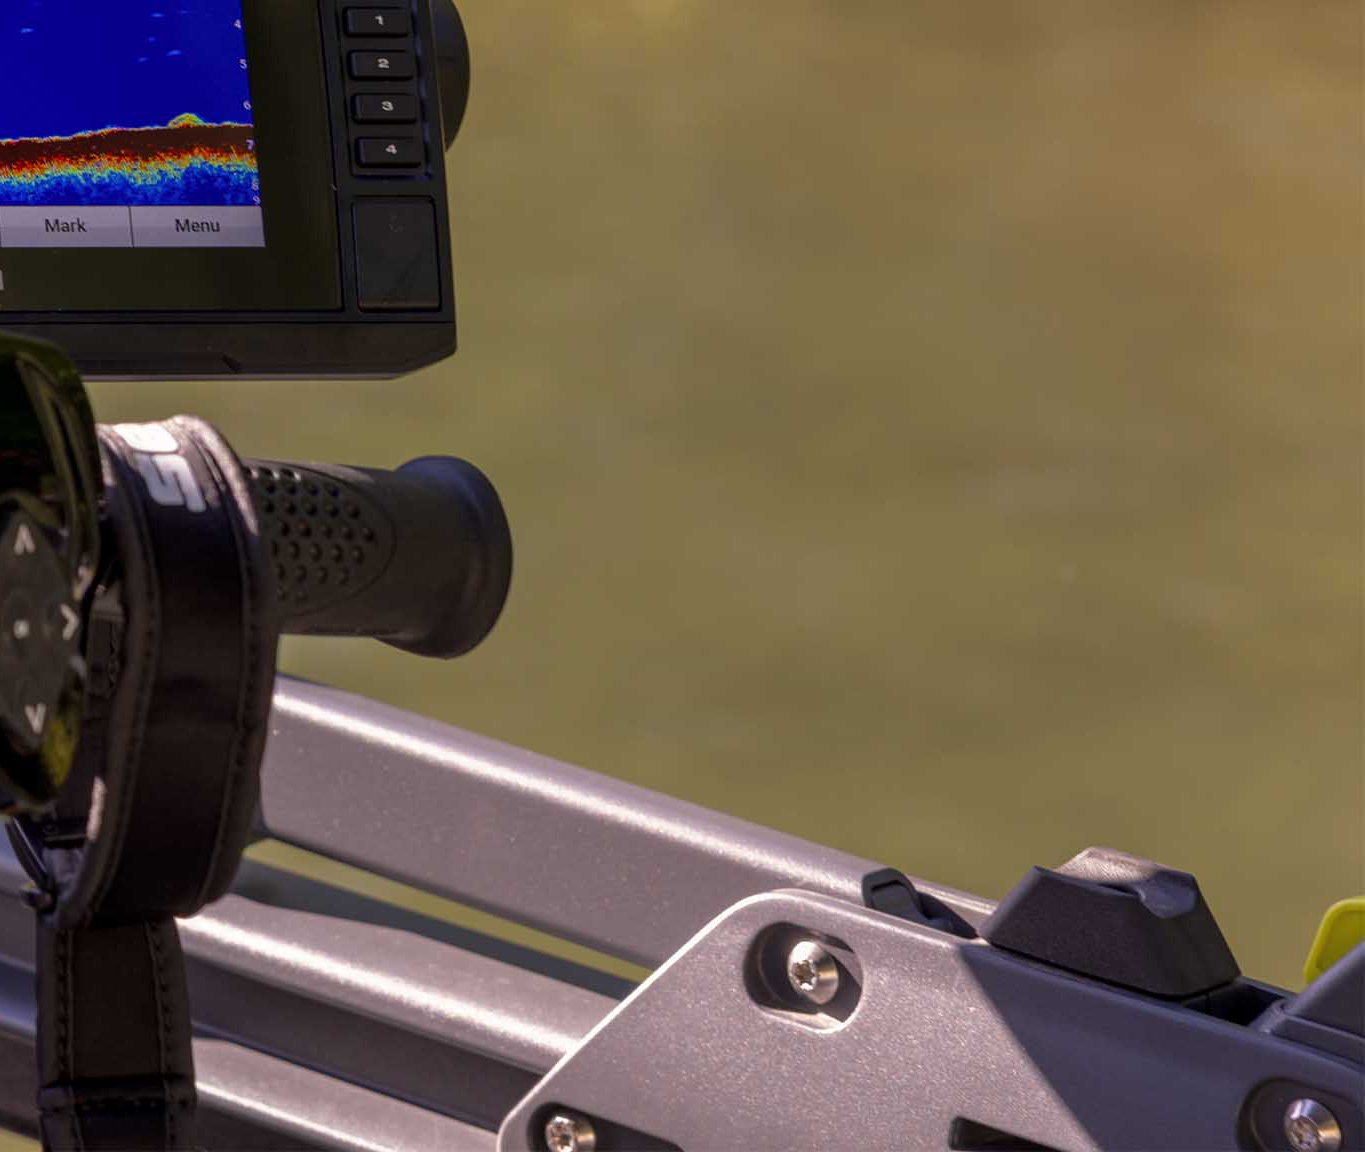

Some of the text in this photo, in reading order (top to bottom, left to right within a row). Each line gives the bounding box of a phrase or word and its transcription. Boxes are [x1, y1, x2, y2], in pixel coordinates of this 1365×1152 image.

[234, 19, 242, 30] 4
[374, 14, 384, 26] 1
[377, 57, 390, 69] 2
[243, 100, 252, 111] 6
[381, 101, 394, 112] 3
[246, 139, 255, 150] 7
[385, 144, 398, 155] 4
[45, 218, 86, 233] Mark
[174, 218, 220, 233] Menu
